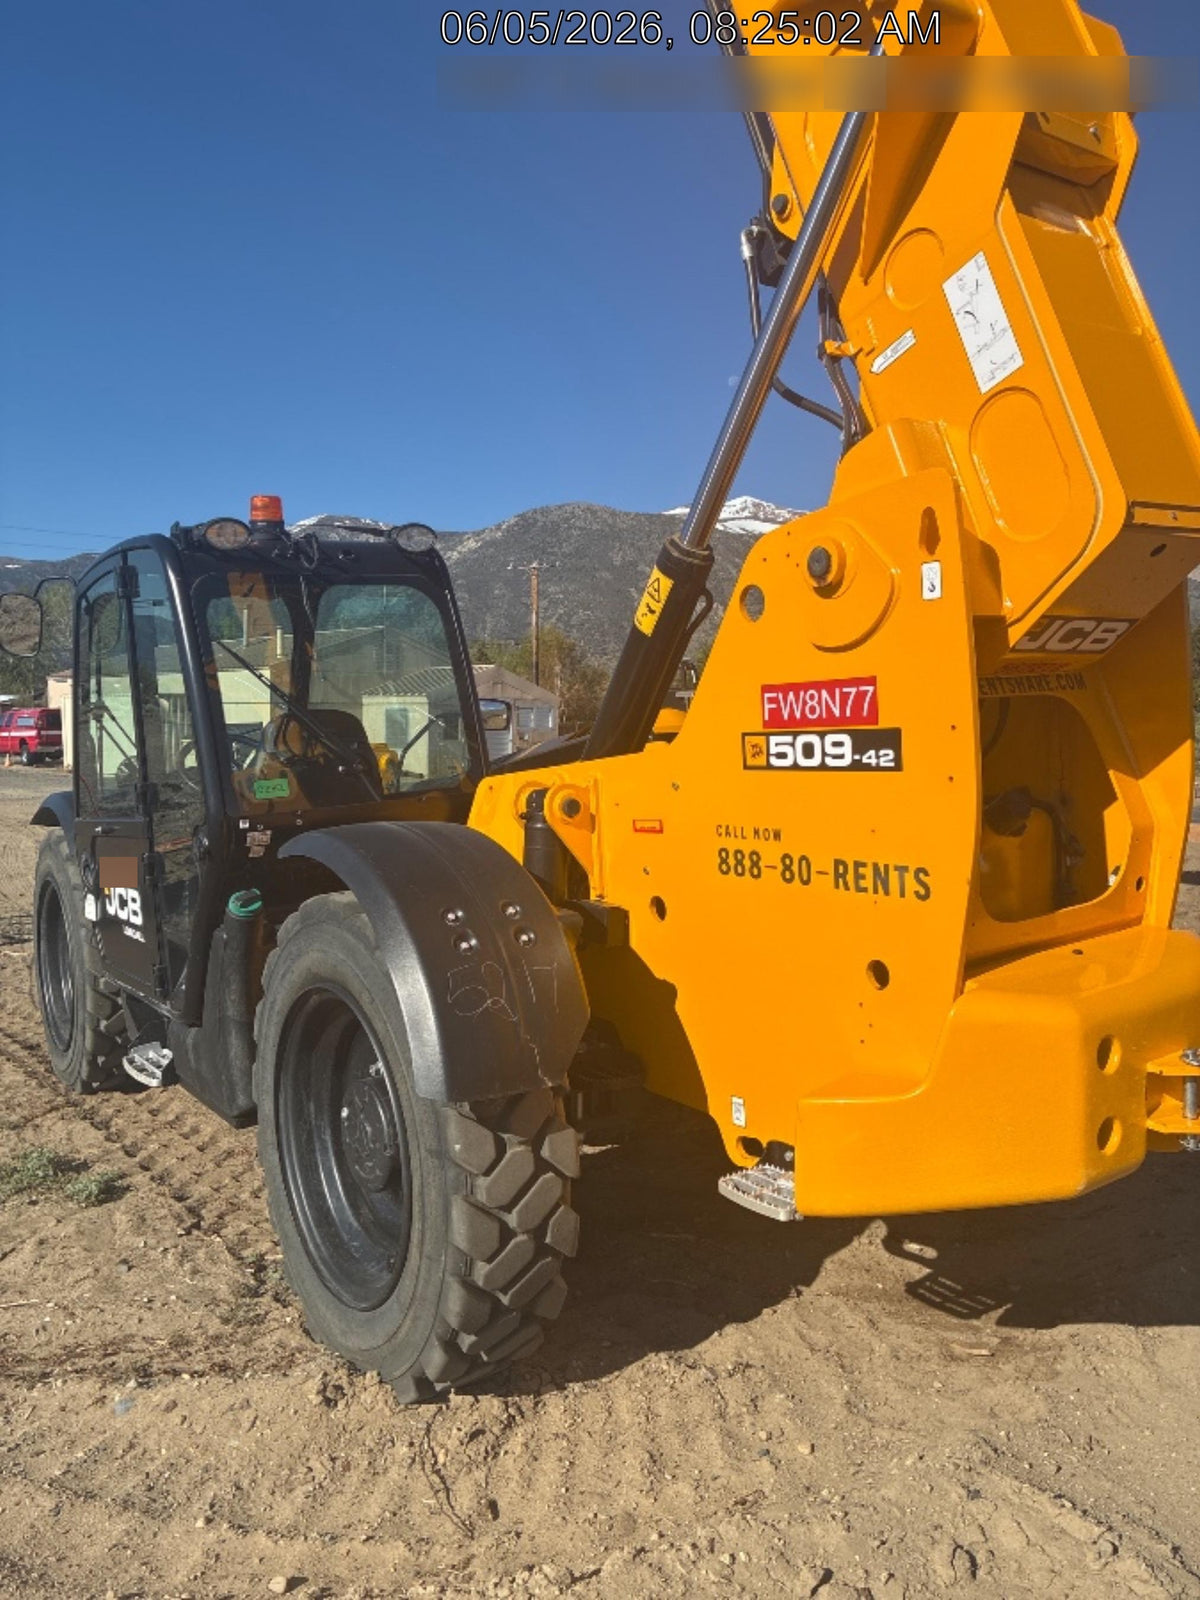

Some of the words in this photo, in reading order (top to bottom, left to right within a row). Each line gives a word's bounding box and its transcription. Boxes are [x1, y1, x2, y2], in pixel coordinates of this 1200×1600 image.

[1015, 620, 1130, 651] JCB
[978, 672, 1087, 695] ENTSHARE.COM
[763, 685, 875, 721] FW8N77
[768, 733, 895, 767] 509-42
[716, 824, 748, 840] CALL
[753, 827, 782, 842] NOW
[717, 847, 931, 902] 888-80-RENTS
[104, 887, 143, 926] JCB
